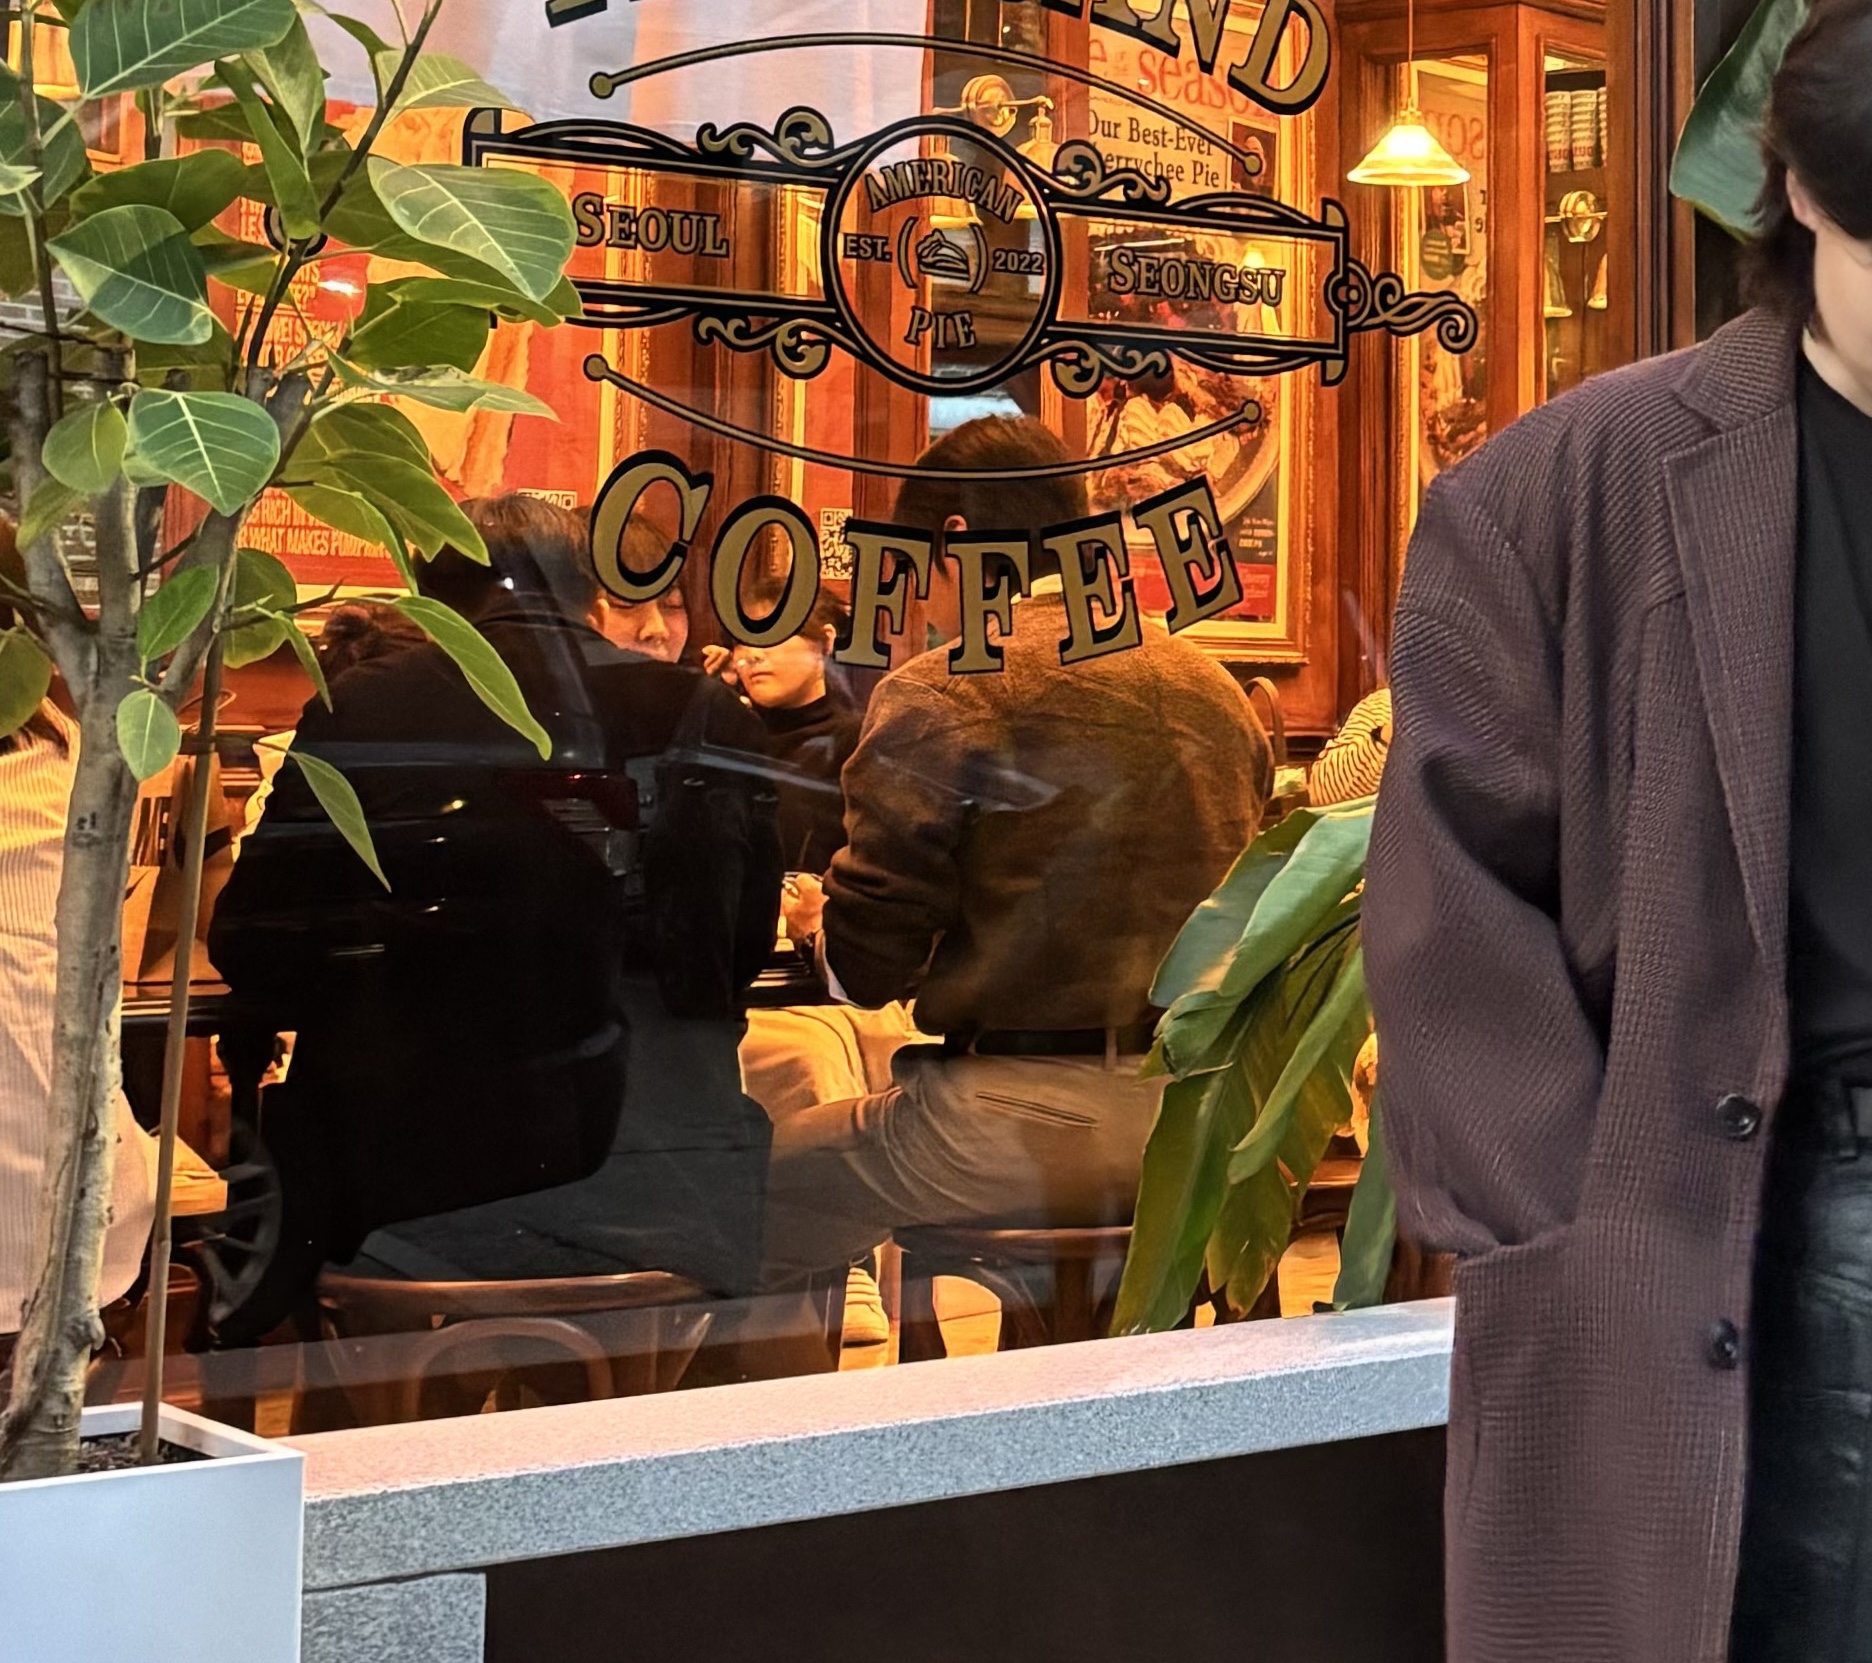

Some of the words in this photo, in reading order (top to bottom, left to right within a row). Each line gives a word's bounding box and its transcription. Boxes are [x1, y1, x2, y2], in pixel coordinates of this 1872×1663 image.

[864, 158, 1026, 225] AMERICAN
[1191, 159, 1220, 188] Pie
[573, 193, 730, 259] SEOUL
[842, 233, 893, 263] EST.
[992, 247, 1045, 276] 2022
[1107, 247, 1287, 307] SEONGSU
[904, 306, 977, 351] PIE
[250, 526, 286, 554] WHAT
[287, 527, 329, 556] MAKES
[591, 449, 1243, 676] COFFEE
